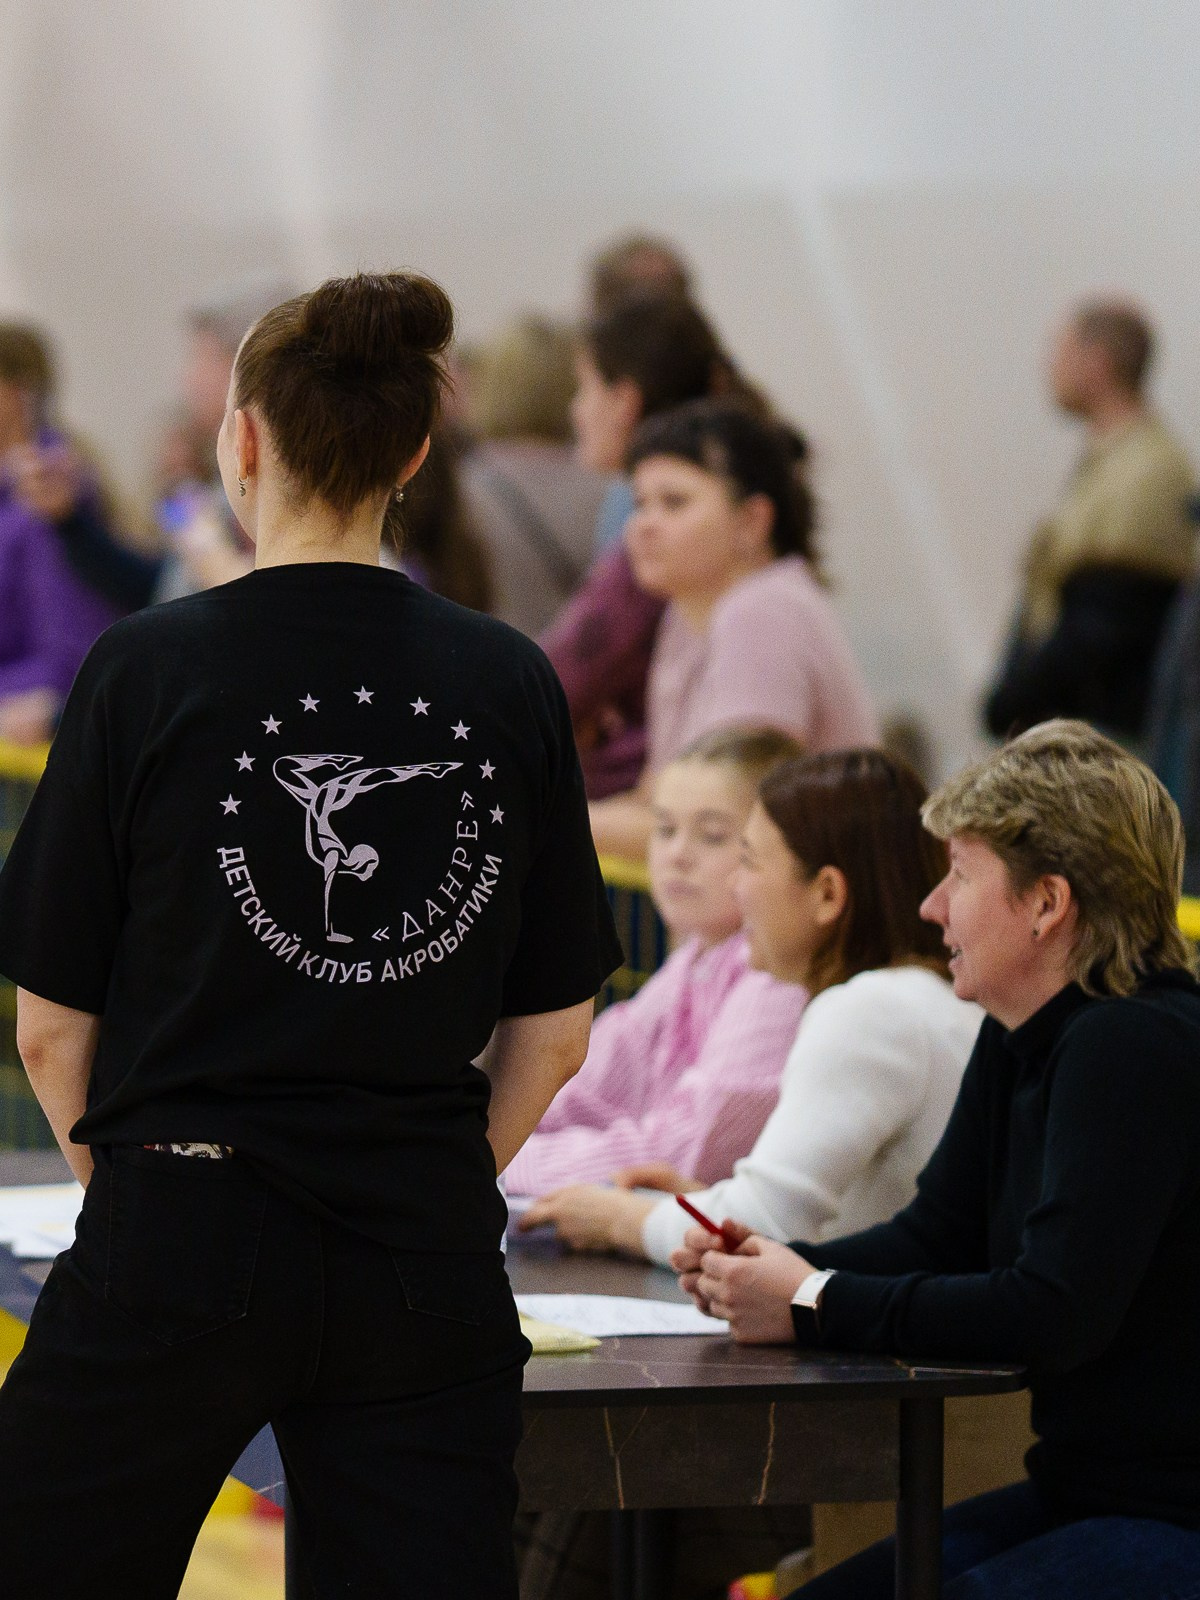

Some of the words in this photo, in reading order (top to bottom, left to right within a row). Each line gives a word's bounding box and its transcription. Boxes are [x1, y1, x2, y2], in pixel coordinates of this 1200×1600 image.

[217, 846, 301, 963] ДЕТСКИЙ
[297, 950, 373, 983] КЛУБ
[380, 854, 502, 982] АКРОБАТИКИ
